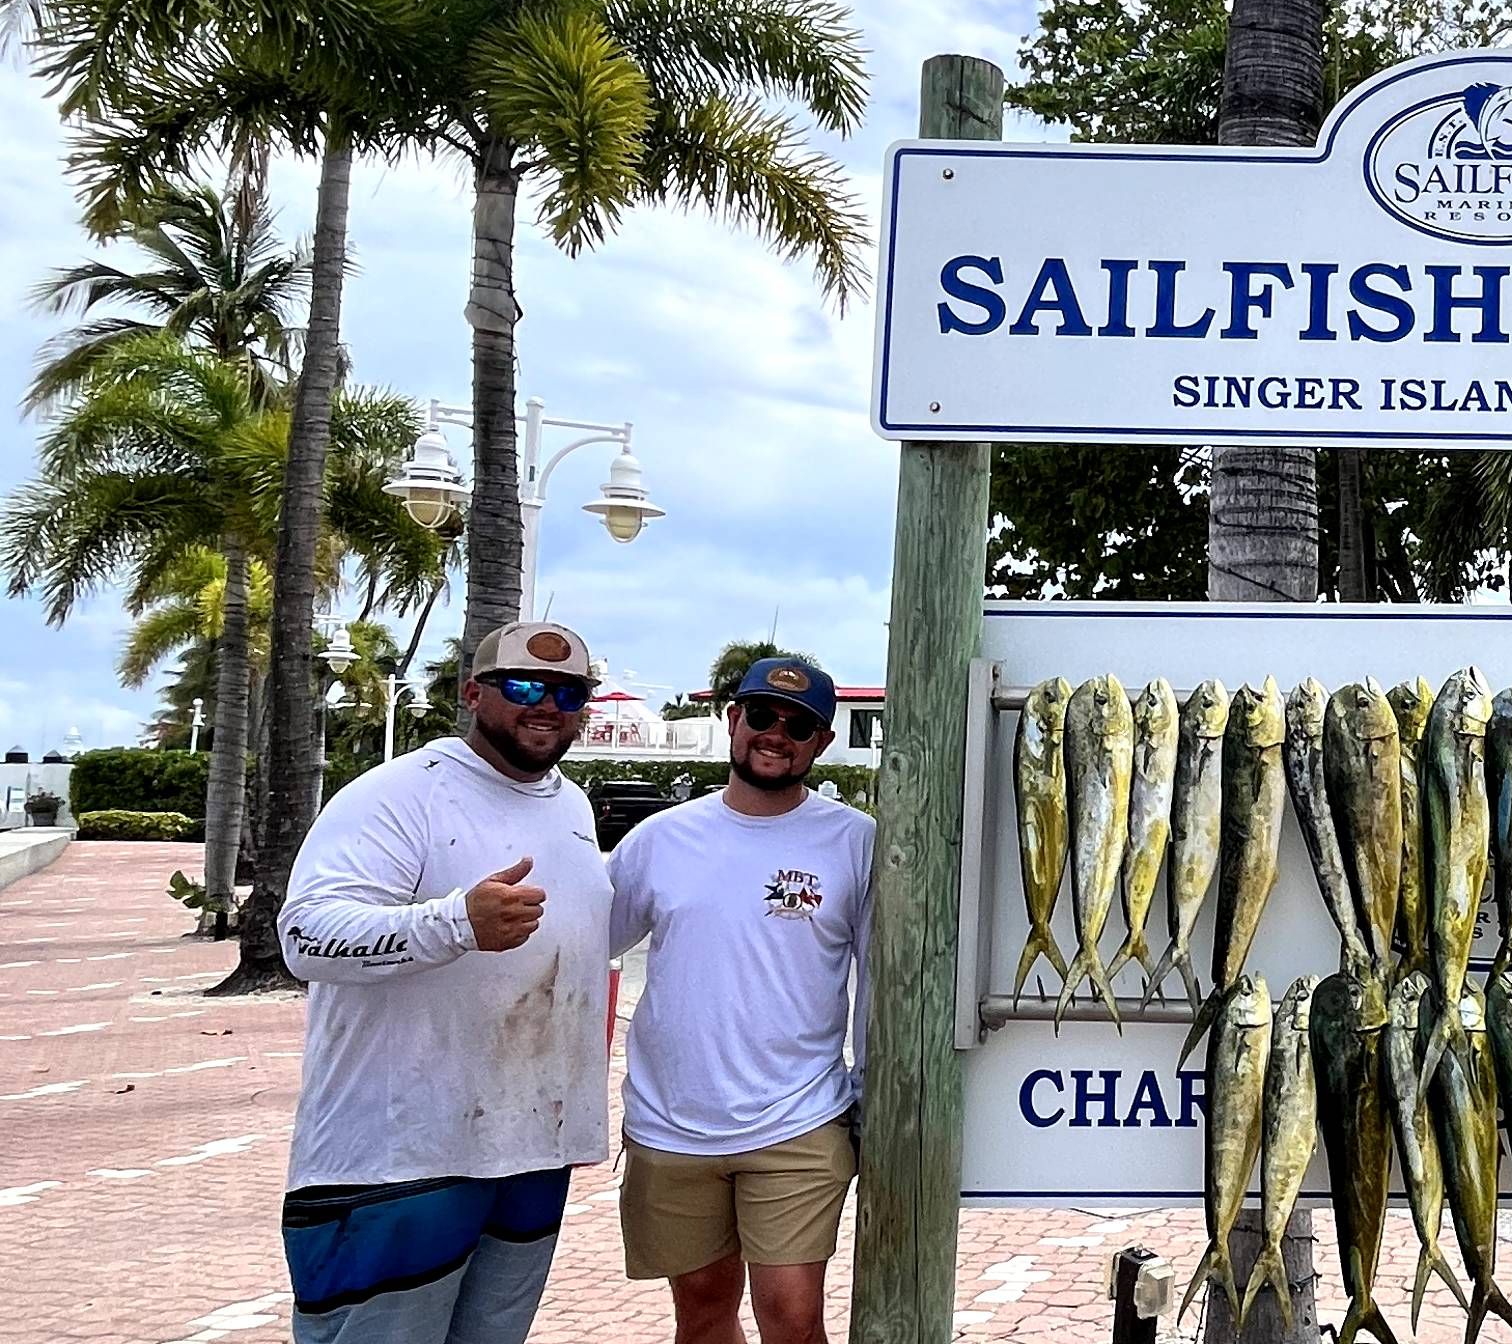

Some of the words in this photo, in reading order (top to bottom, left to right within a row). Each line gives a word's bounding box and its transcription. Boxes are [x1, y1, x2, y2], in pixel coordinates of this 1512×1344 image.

[937, 254, 1511, 344] SAILFISH
[1173, 374, 1363, 411] SINGER
[777, 869, 819, 887] MBT
[1018, 1069, 1207, 1128] CHAR
